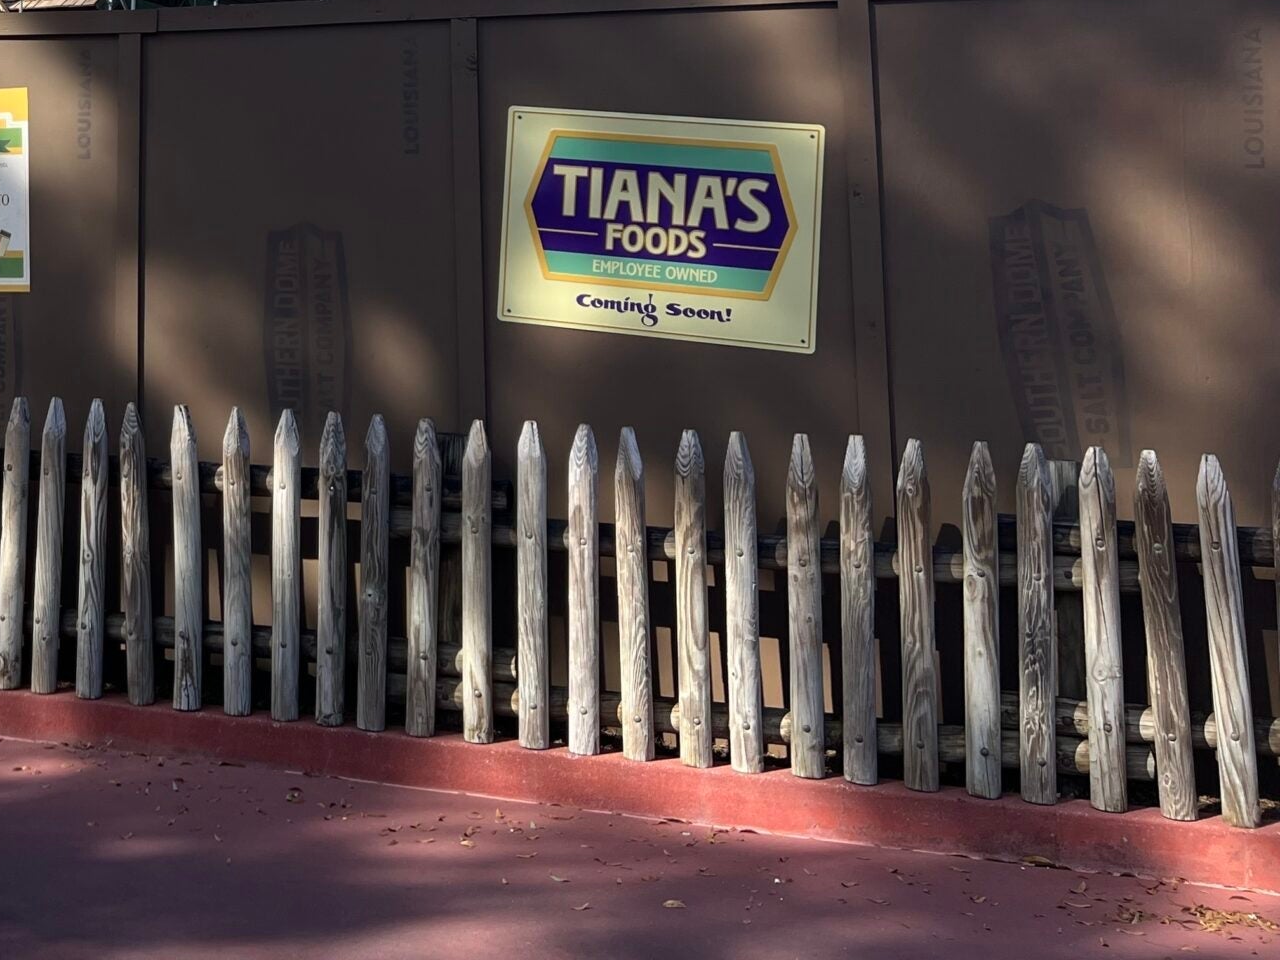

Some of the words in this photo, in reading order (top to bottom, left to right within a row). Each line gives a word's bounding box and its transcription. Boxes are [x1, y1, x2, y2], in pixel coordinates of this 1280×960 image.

[77, 48, 92, 160] LOUISIANA
[1243, 27, 1265, 169] LOUISIANA
[553, 164, 772, 234] TIANA'S
[591, 259, 662, 279] EMPLOYEE
[665, 266, 718, 284] OWNED
[604, 223, 708, 259] FOODS
[1004, 224, 1041, 303] DOME
[311, 257, 335, 366] COMPANY
[575, 293, 658, 328] Coming
[665, 302, 733, 324] Soon!
